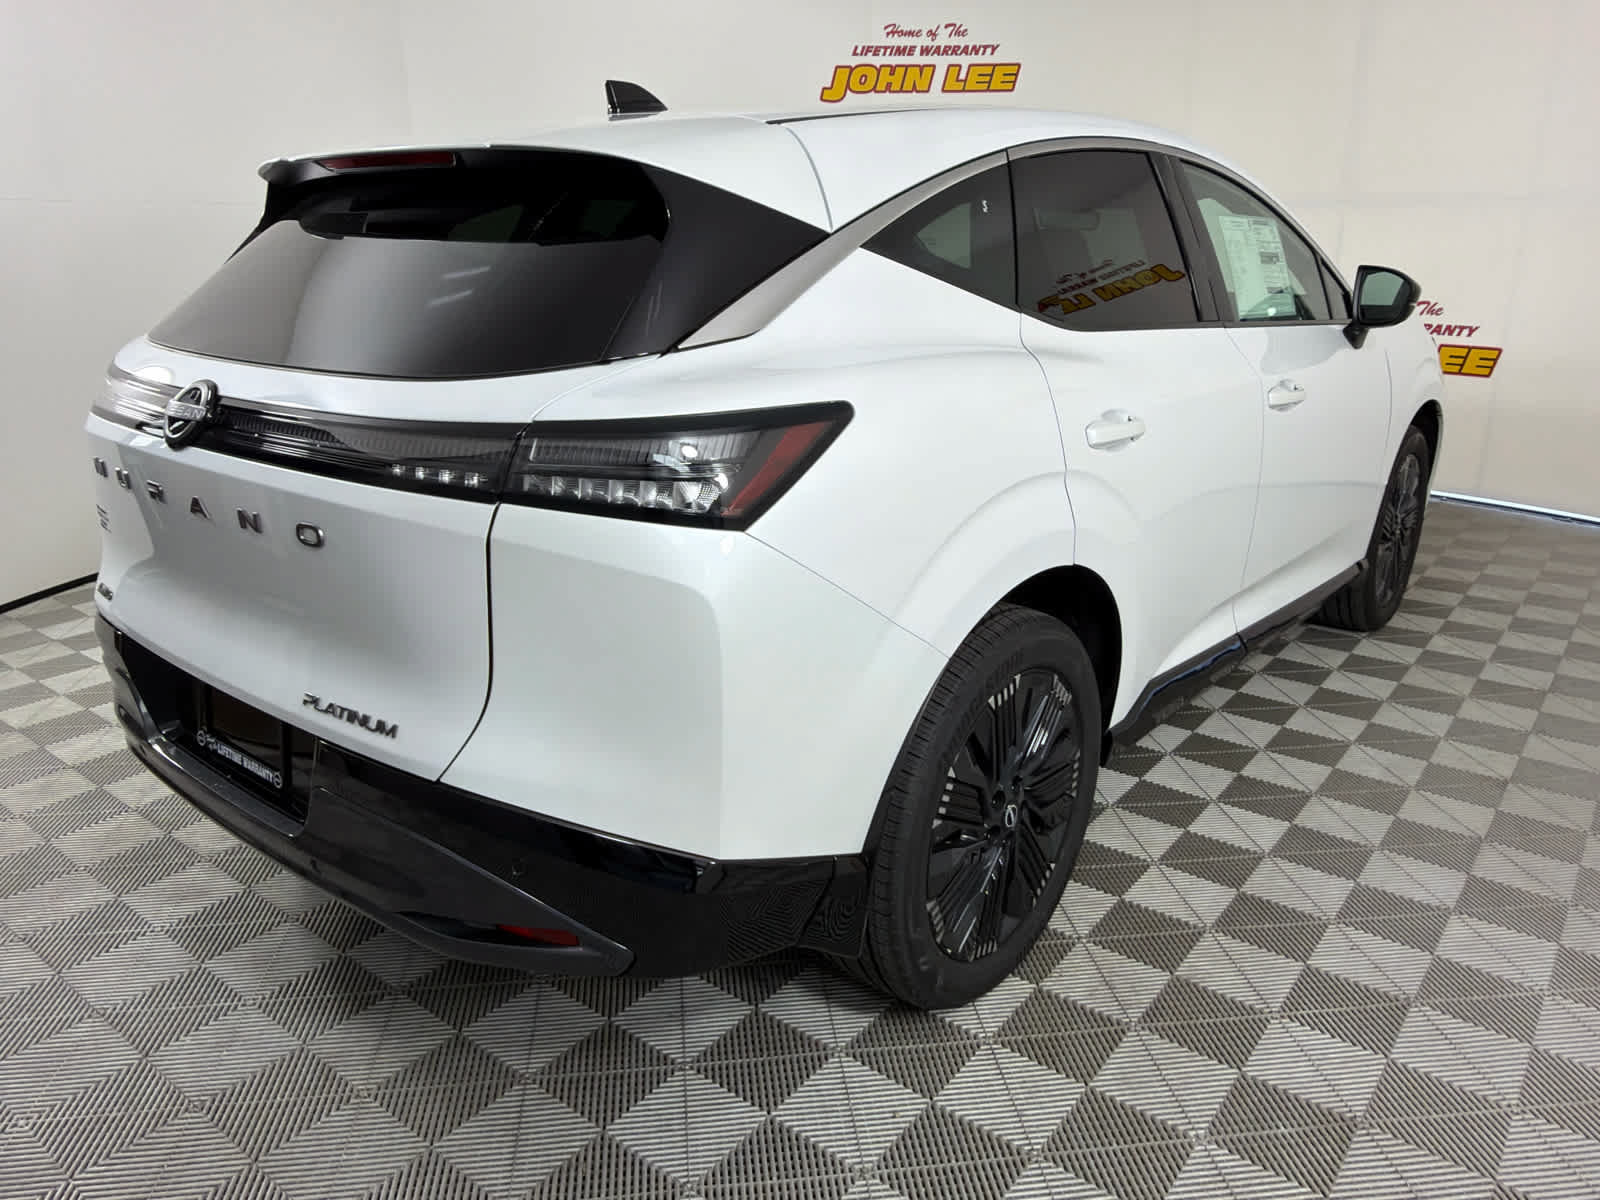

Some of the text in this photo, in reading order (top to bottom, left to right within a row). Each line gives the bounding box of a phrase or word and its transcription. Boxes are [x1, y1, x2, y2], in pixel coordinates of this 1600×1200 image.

[884, 23, 968, 41] Home of The
[851, 44, 1000, 57] LIFETIME WARRANTY
[820, 63, 1021, 103] JOHN LEE
[1416, 301, 1444, 316] The
[1438, 344, 1503, 378] EE
[94, 457, 325, 549] MURANO
[303, 691, 399, 739] PLATINUM
